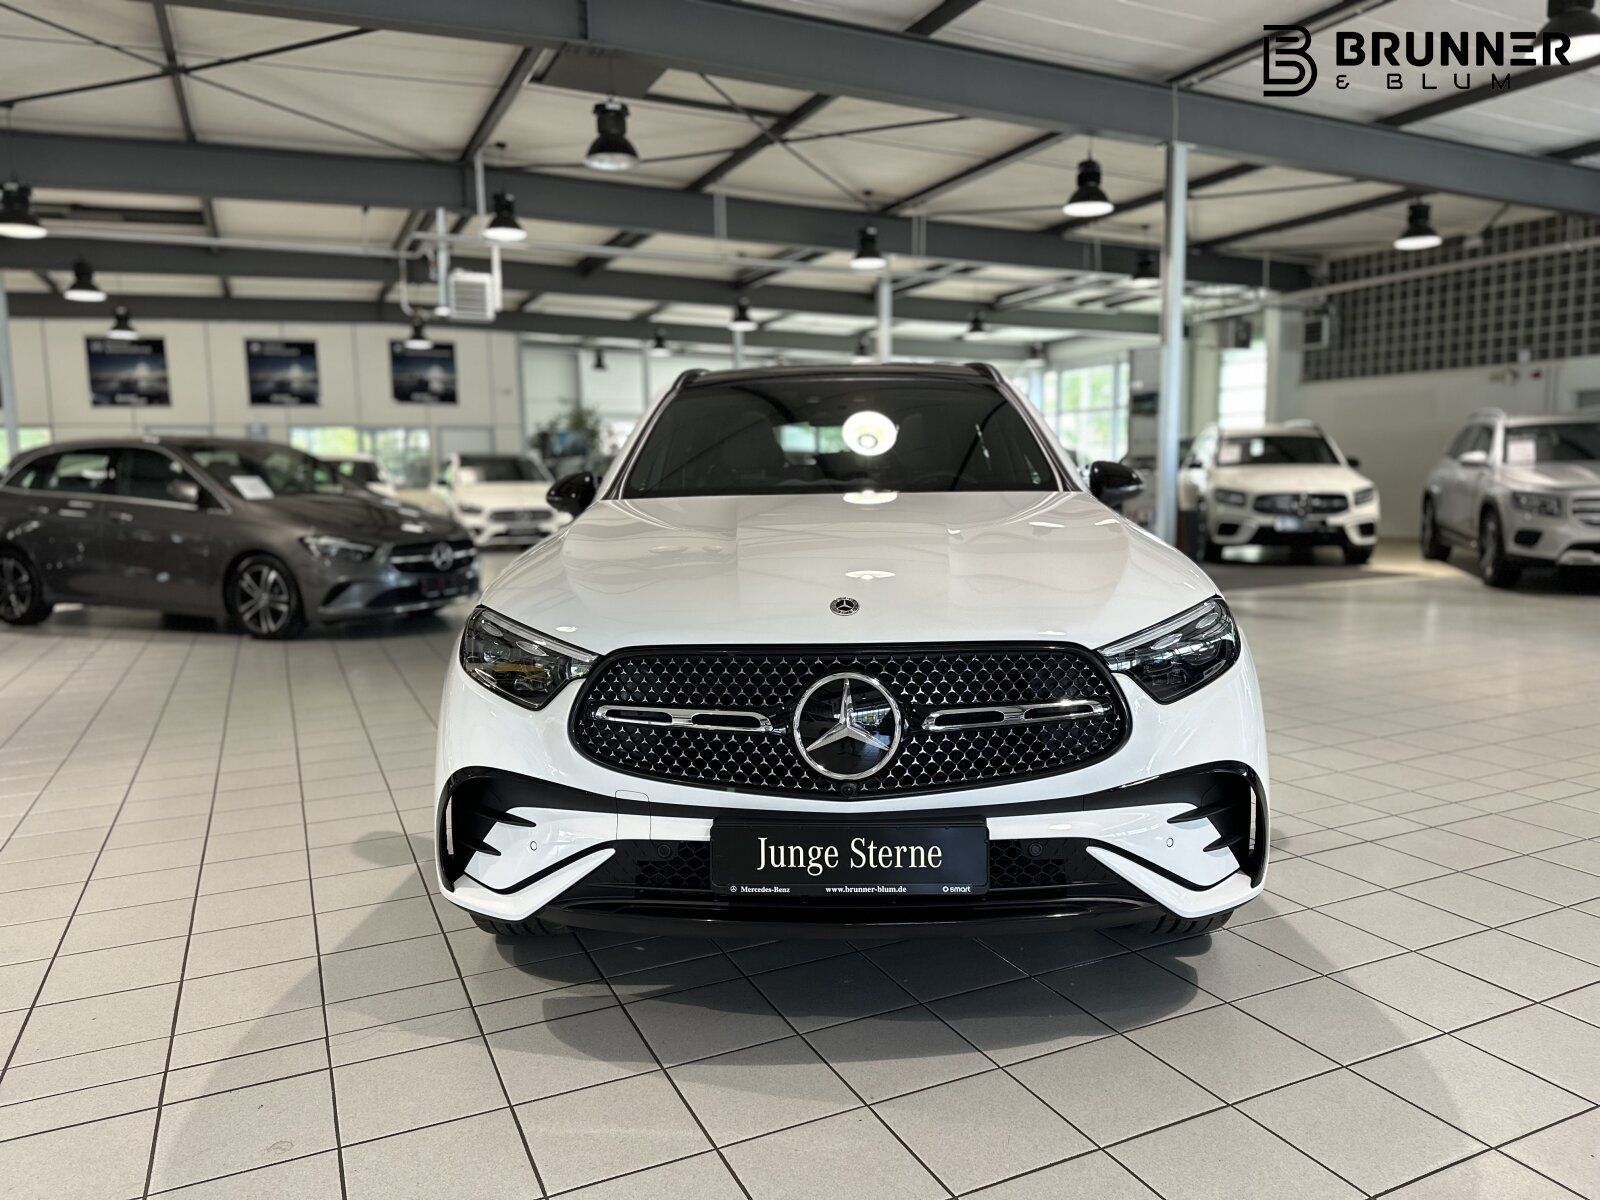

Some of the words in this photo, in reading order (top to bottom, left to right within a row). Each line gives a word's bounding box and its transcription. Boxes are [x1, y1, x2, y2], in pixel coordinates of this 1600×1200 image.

[757, 837, 839, 876] Junge
[850, 837, 942, 869] Sterne
[740, 886, 791, 894] Mercedes-Benz
[825, 884, 907, 893] www.brunner-blum.de
